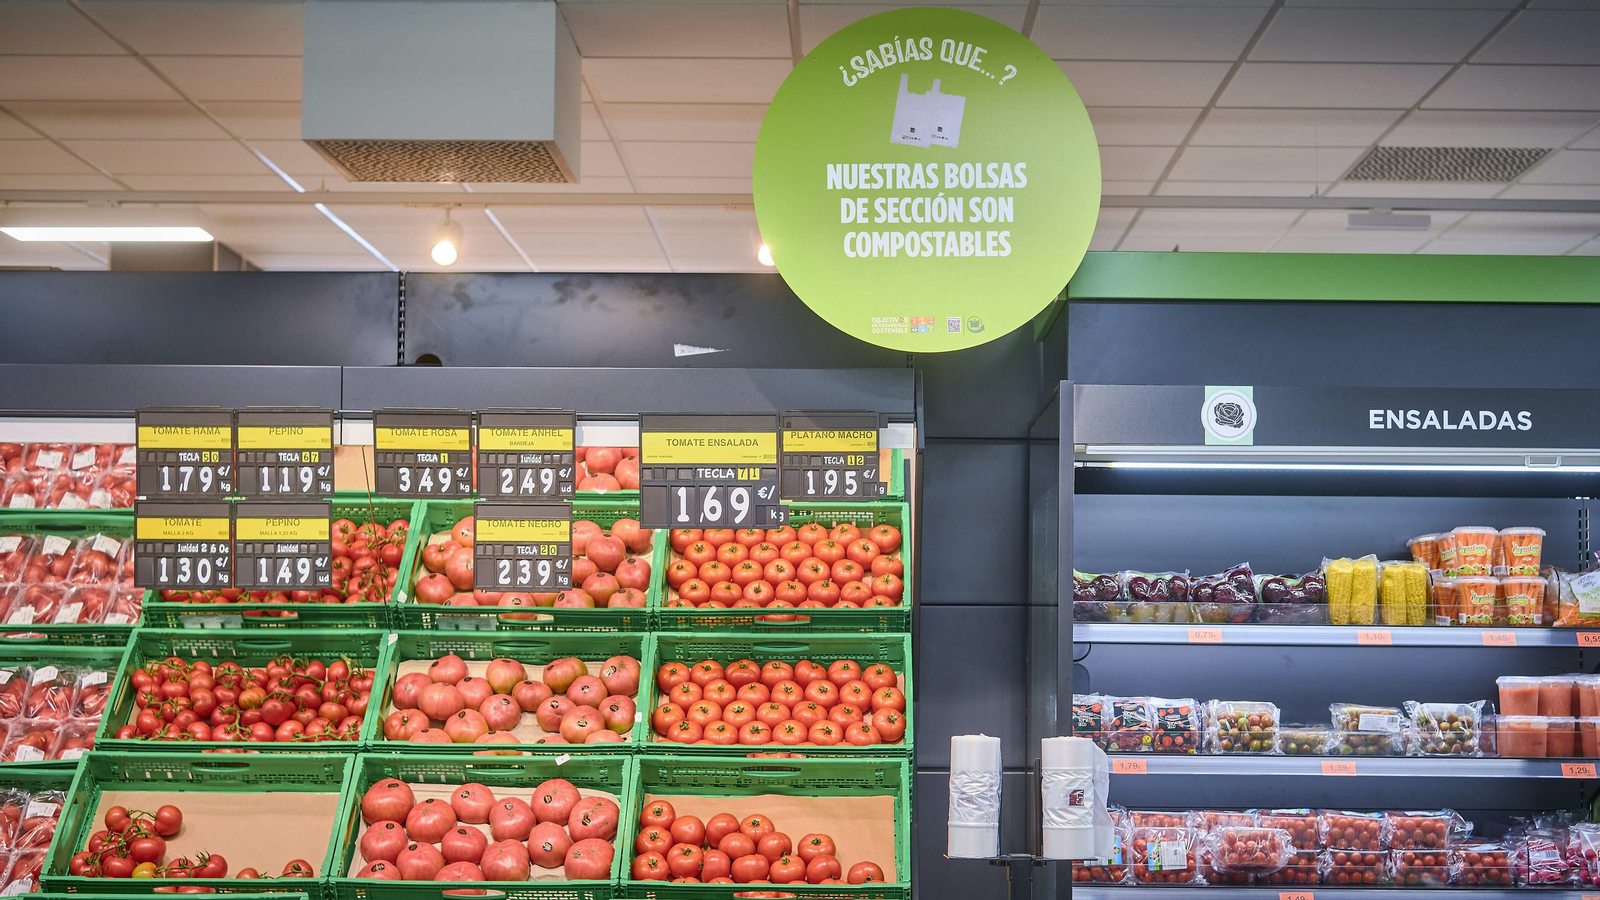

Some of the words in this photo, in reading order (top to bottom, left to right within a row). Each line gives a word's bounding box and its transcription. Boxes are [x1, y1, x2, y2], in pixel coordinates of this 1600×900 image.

[839, 36, 933, 87] ¿SABÍAS
[827, 163, 939, 189] NUESTRAS
[944, 162, 1027, 189] BOLSAS
[840, 197, 869, 224] DE
[874, 192, 964, 224] SECCIÓN
[969, 196, 1014, 223] SON
[843, 230, 1012, 258] COMPOSTABLES
[1369, 409, 1533, 431] ENSALADAS
[152, 427, 191, 436] TOMATE
[193, 427, 221, 436] RAMA
[269, 427, 304, 436] PEPINO
[389, 429, 428, 437] TOMATE
[431, 429, 458, 437] ROSA
[490, 429, 529, 437] TOMATE
[531, 429, 563, 437] ANHEL
[838, 431, 873, 439] MACHO
[666, 438, 705, 447] TOMATE
[707, 438, 759, 447] ENSALADA
[179, 452, 200, 462] TECLA
[278, 452, 300, 462] TECLA
[417, 453, 438, 463] TECLA
[823, 456, 845, 465] TECLA
[697, 468, 735, 479] TECLA
[162, 466, 213, 492] 1,79
[261, 466, 313, 493] 1,19
[806, 469, 858, 495] 1,95
[220, 482, 231, 492] kg
[321, 482, 331, 492] kg
[459, 483, 470, 493] kg
[561, 483, 572, 493] ud
[677, 486, 750, 524] 1,69
[163, 518, 202, 527] TOMATE
[265, 518, 300, 527] PEPINO
[486, 520, 526, 528] TOMATE
[527, 520, 562, 528] NEGRO
[516, 545, 538, 555] TECLA
[218, 572, 229, 583] kg
[318, 574, 330, 583] ud
[558, 575, 569, 585] kg
